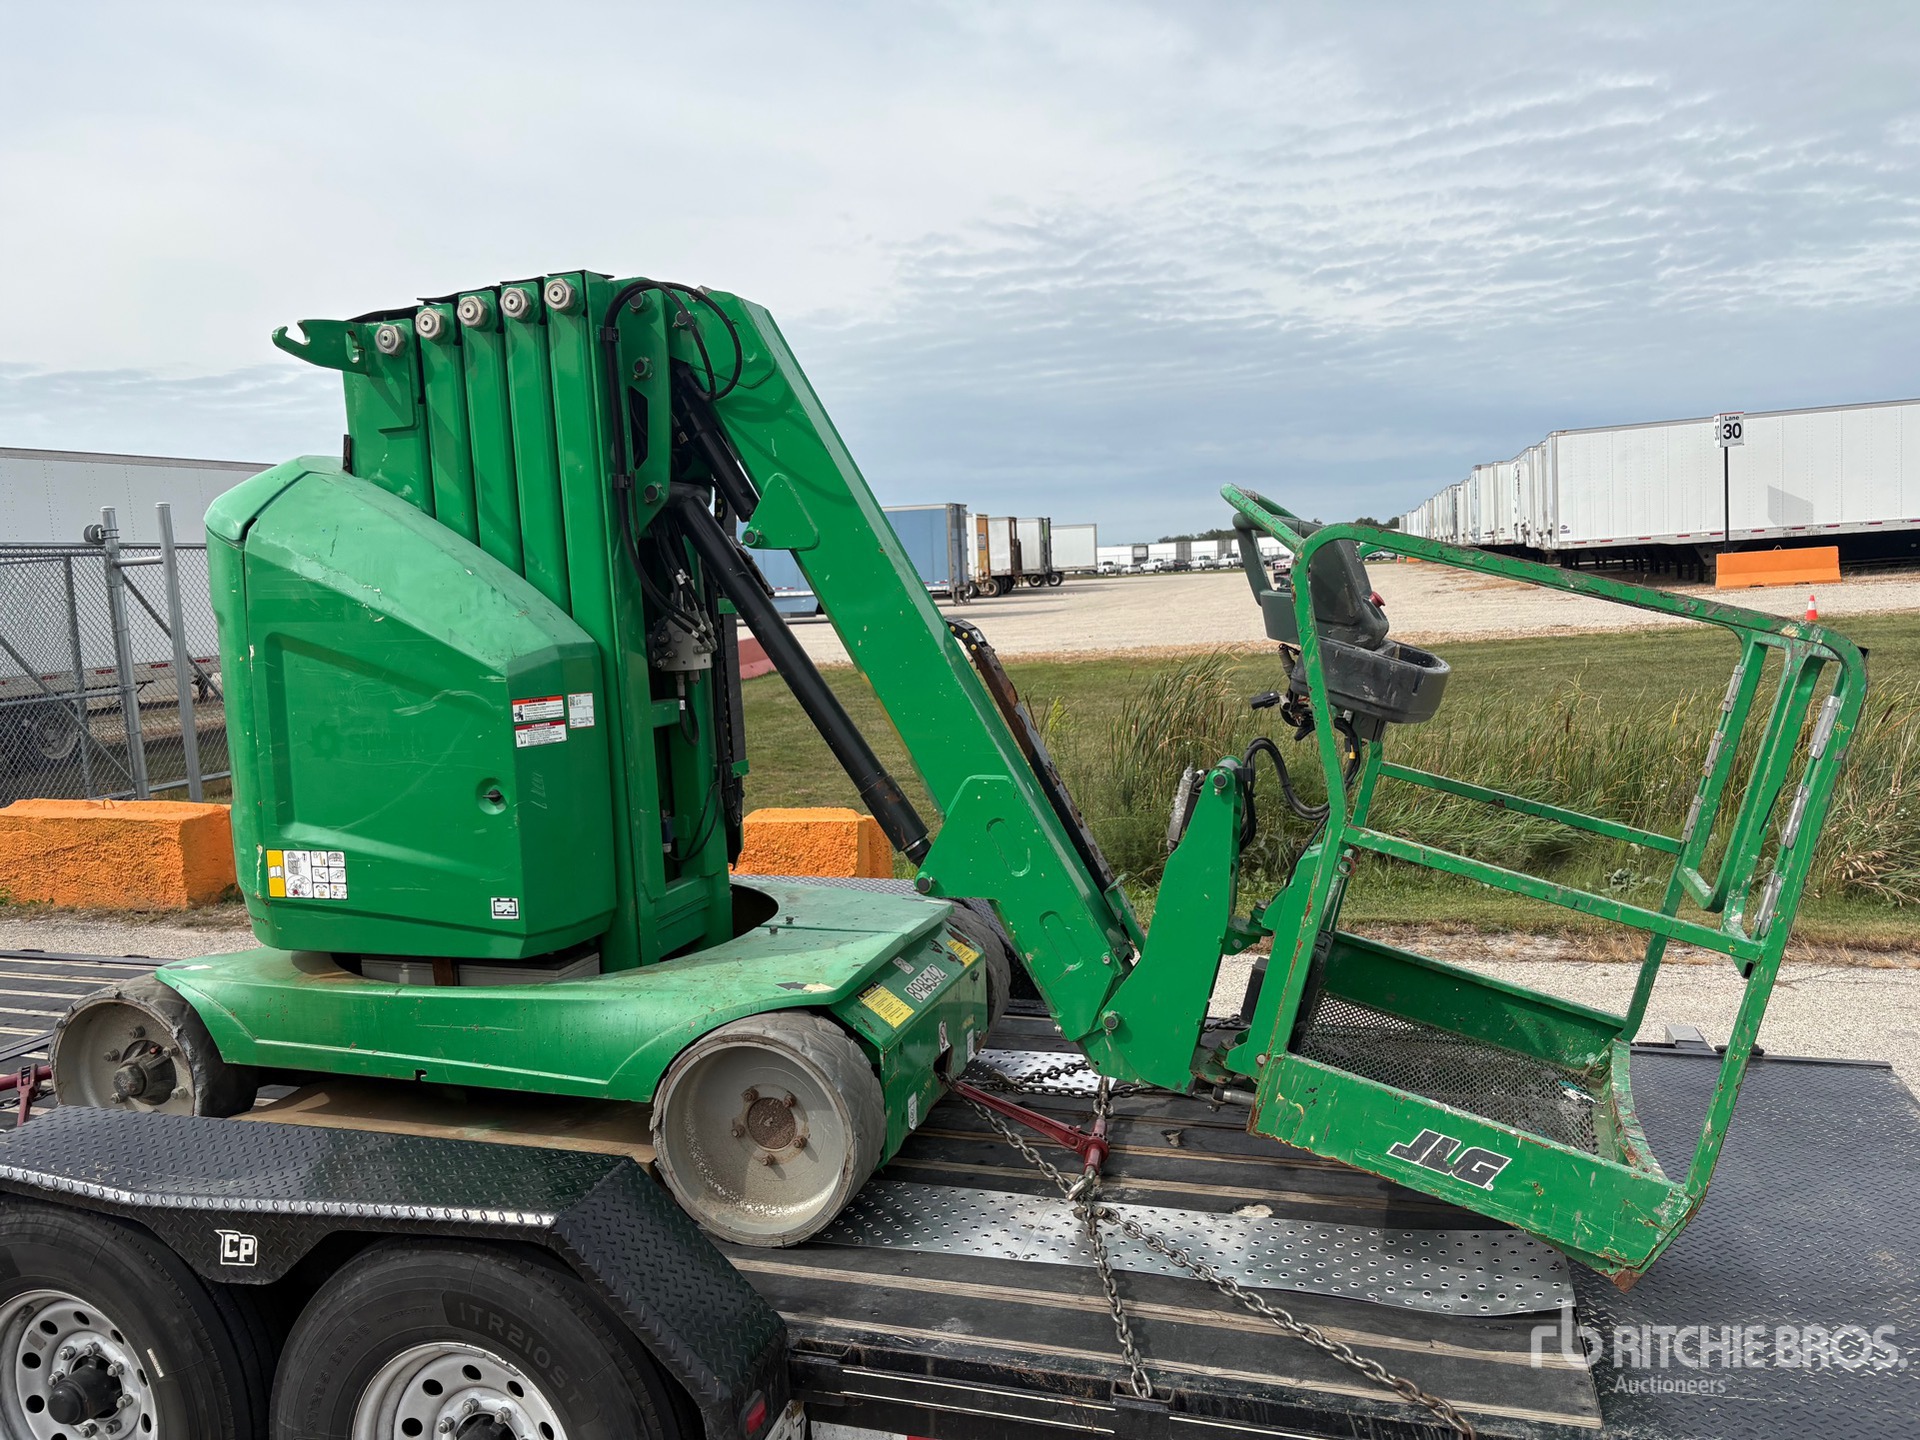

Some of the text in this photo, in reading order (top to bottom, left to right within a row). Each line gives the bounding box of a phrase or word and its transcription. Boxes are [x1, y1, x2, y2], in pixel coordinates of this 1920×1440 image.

[1723, 423, 1742, 440] 30
[905, 965, 947, 1001] 898542
[1386, 1128, 1513, 1187] JLG
[222, 1233, 256, 1262] CP
